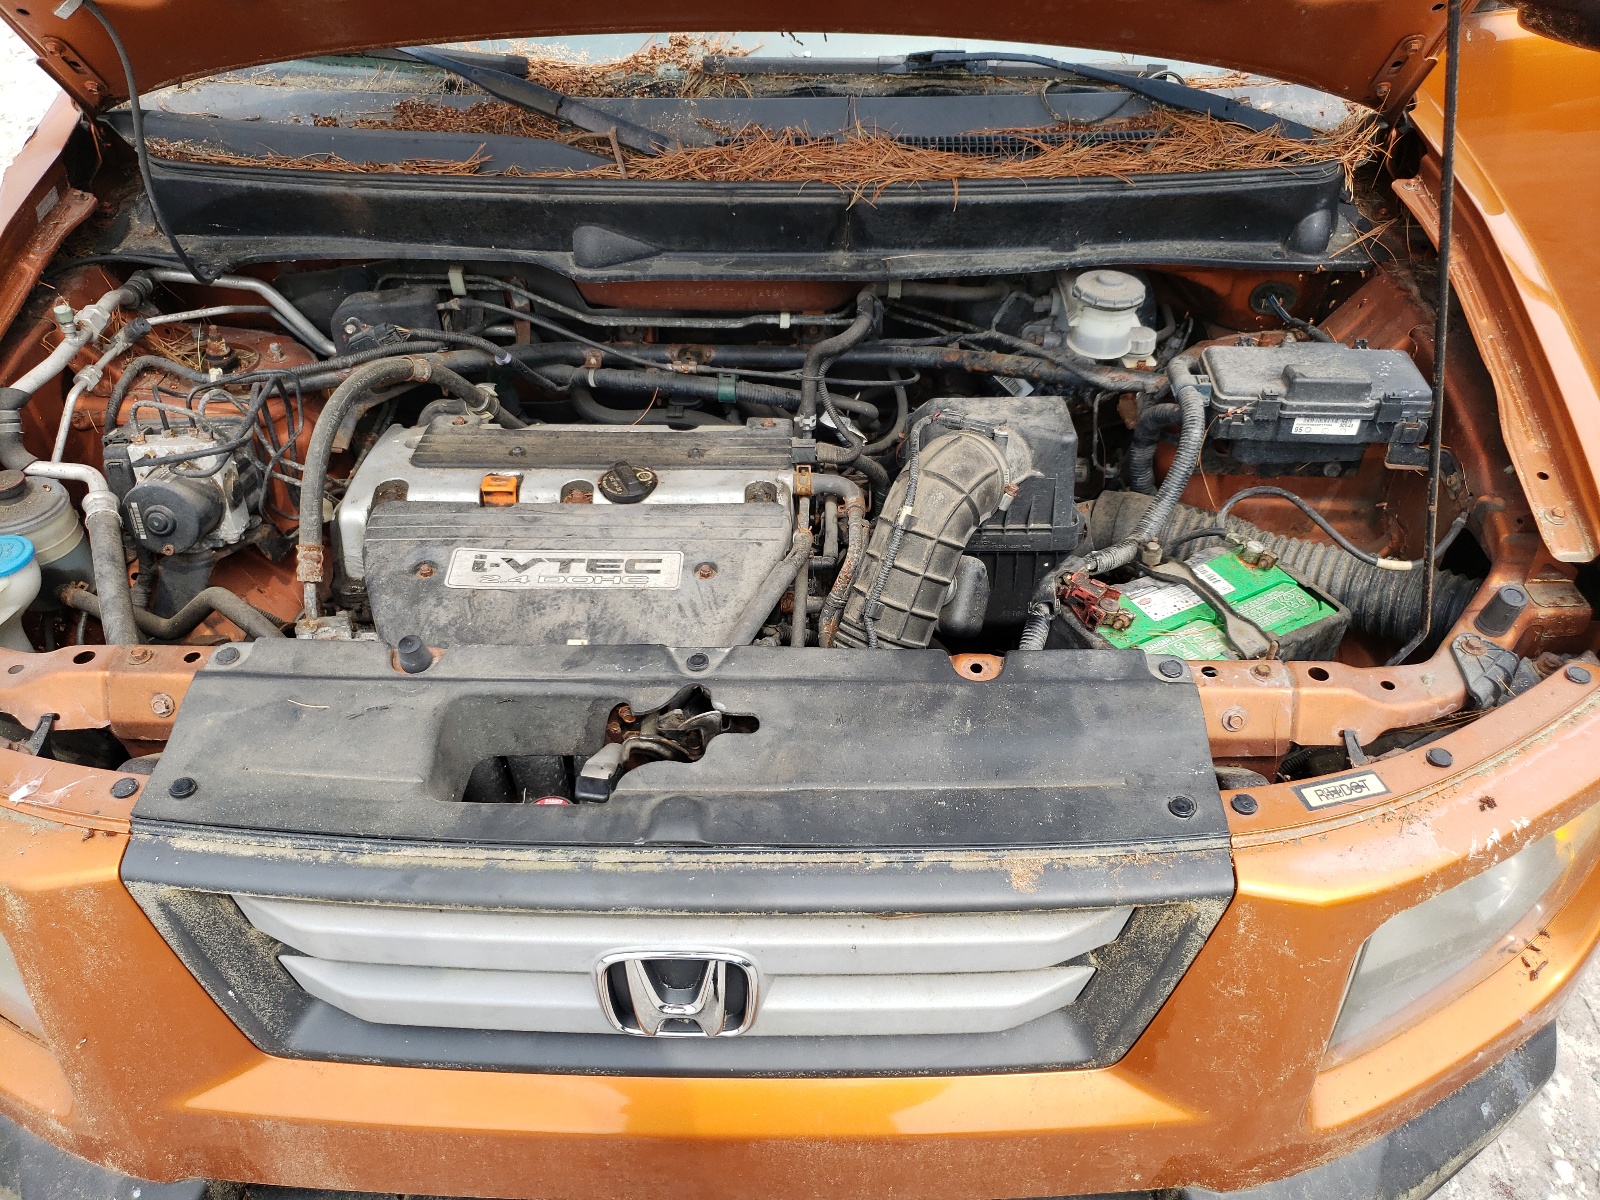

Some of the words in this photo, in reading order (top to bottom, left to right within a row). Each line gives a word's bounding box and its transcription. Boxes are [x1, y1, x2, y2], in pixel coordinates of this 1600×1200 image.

[472, 554, 663, 574] i-VTEC
[479, 575, 530, 585] 2.4
[538, 575, 650, 585] DOHC
